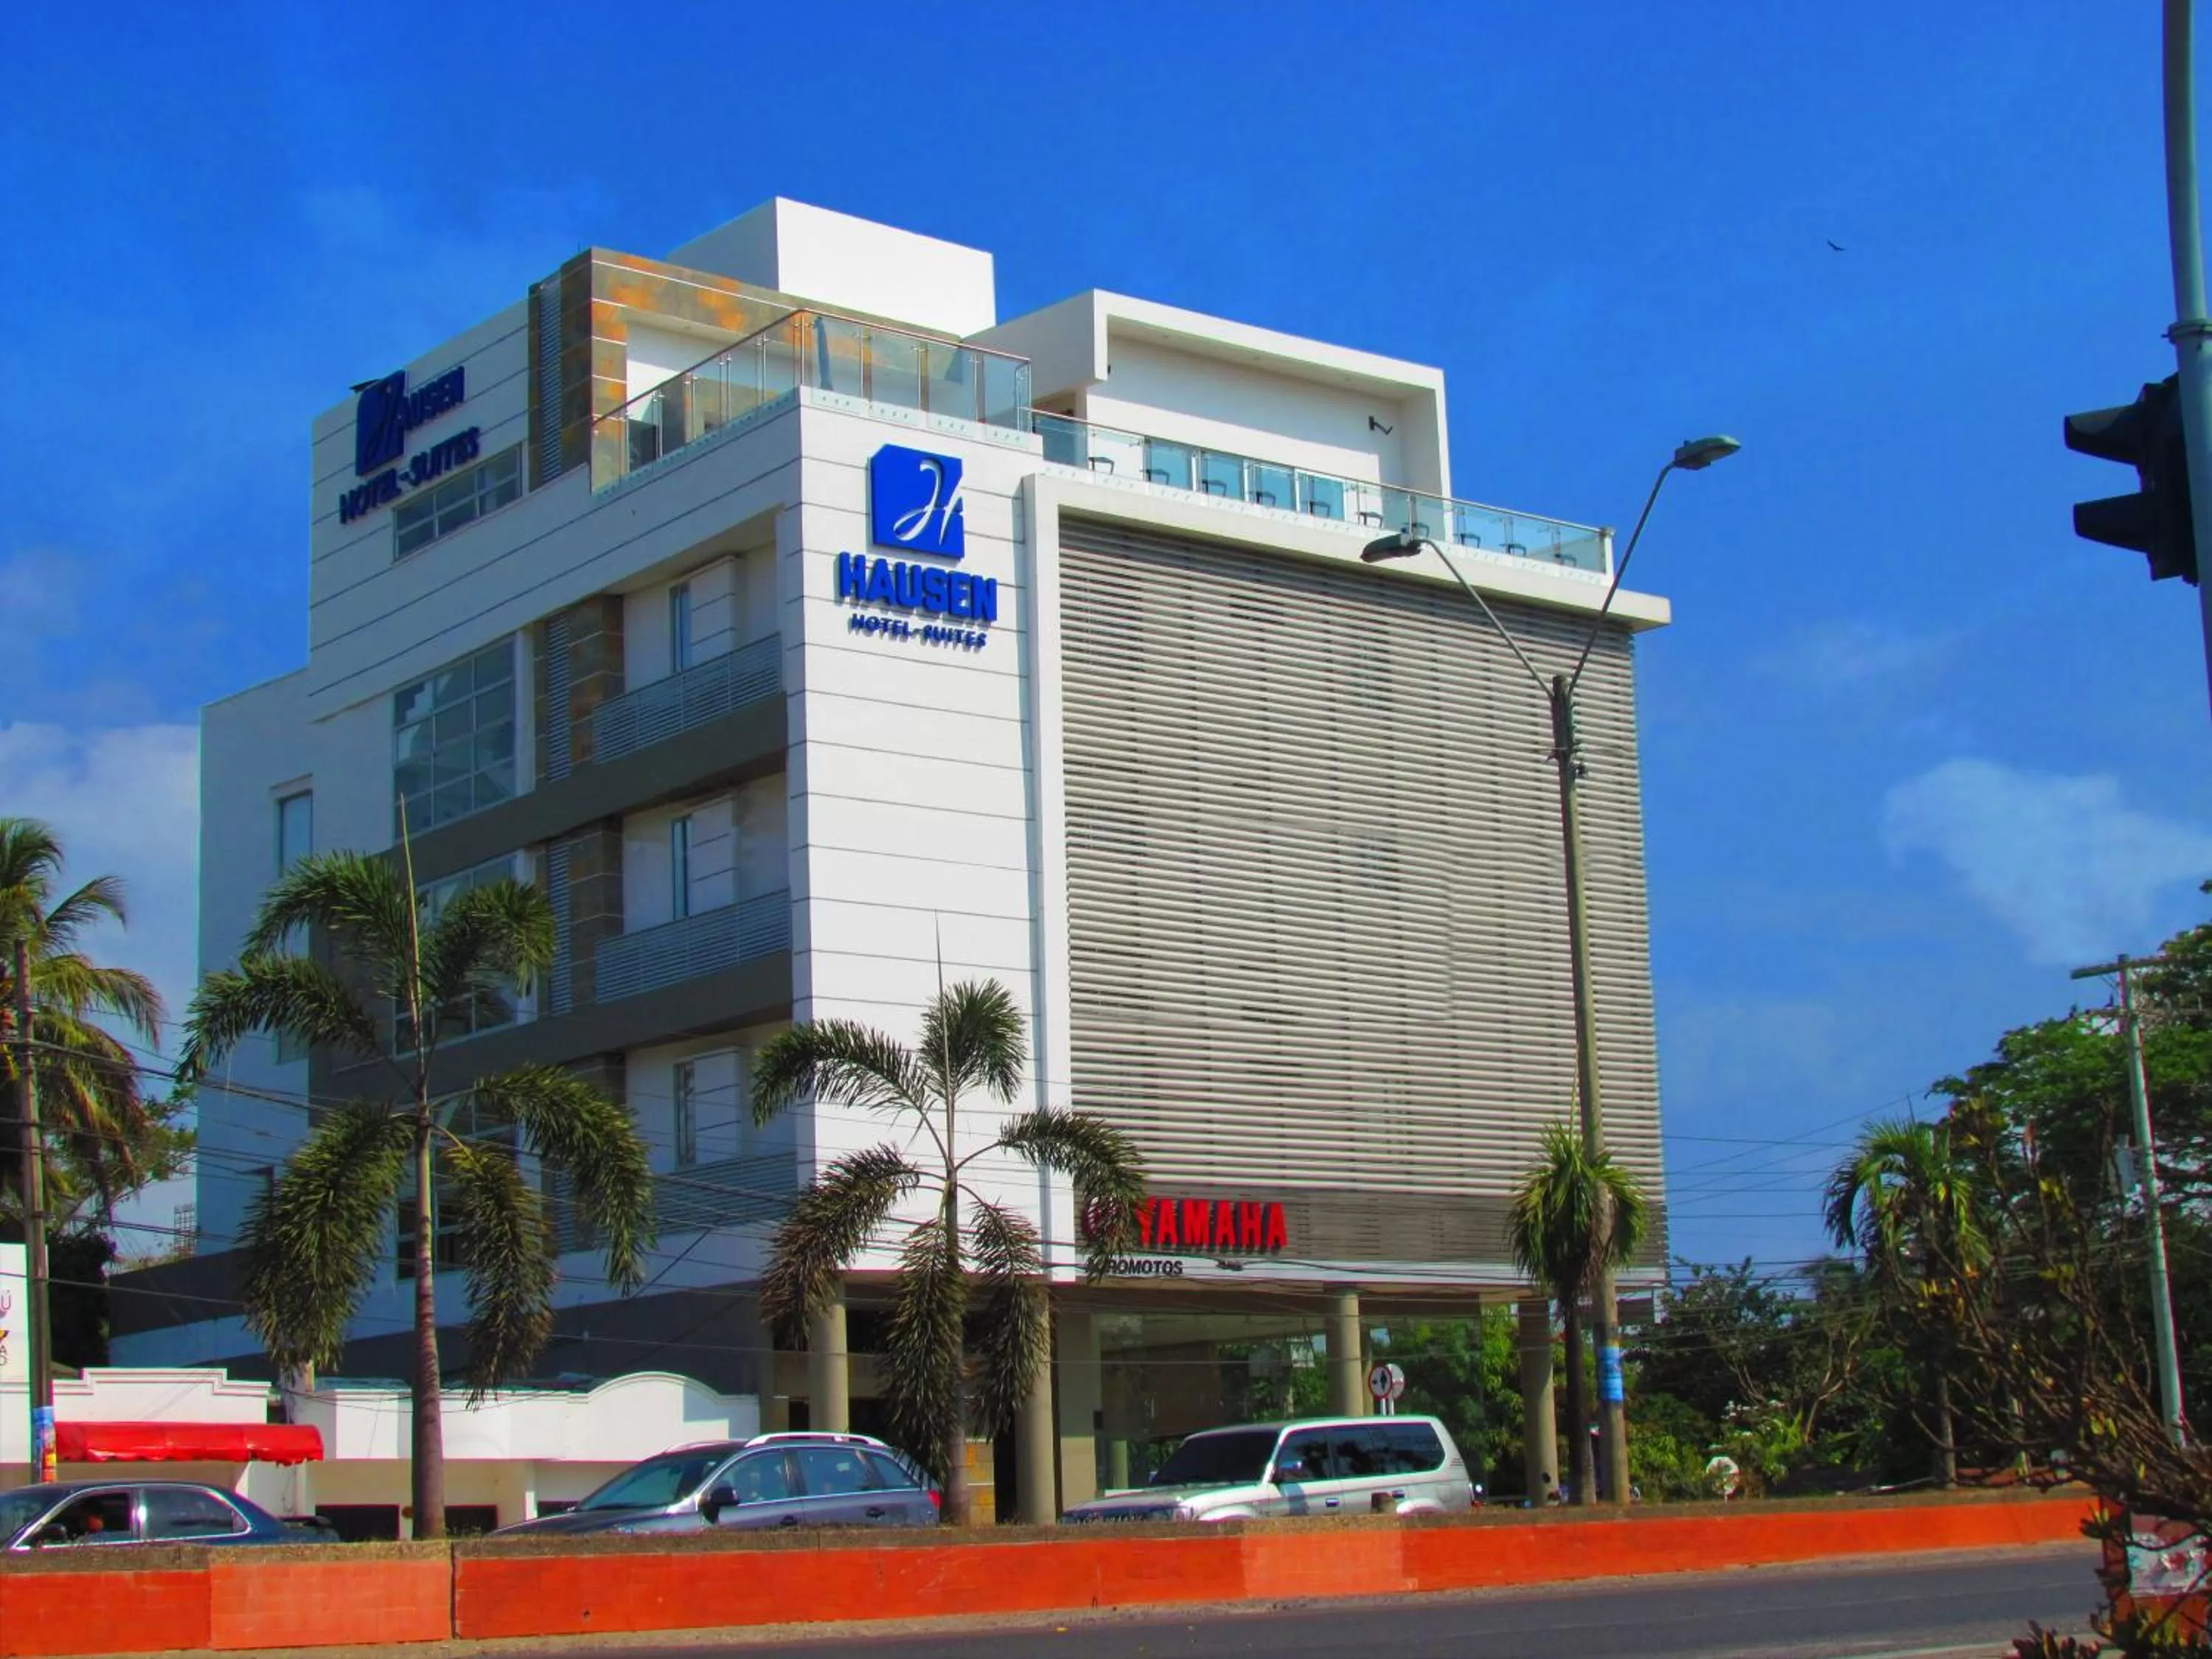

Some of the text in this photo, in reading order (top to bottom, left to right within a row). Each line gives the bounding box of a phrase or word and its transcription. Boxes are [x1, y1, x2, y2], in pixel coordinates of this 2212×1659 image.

[393, 366, 465, 431] AUSEN
[837, 552, 997, 622] HAUSEN
[1135, 1194, 1287, 1248] YAMAHA
[1087, 1256, 1183, 1276] ROMOTOS
